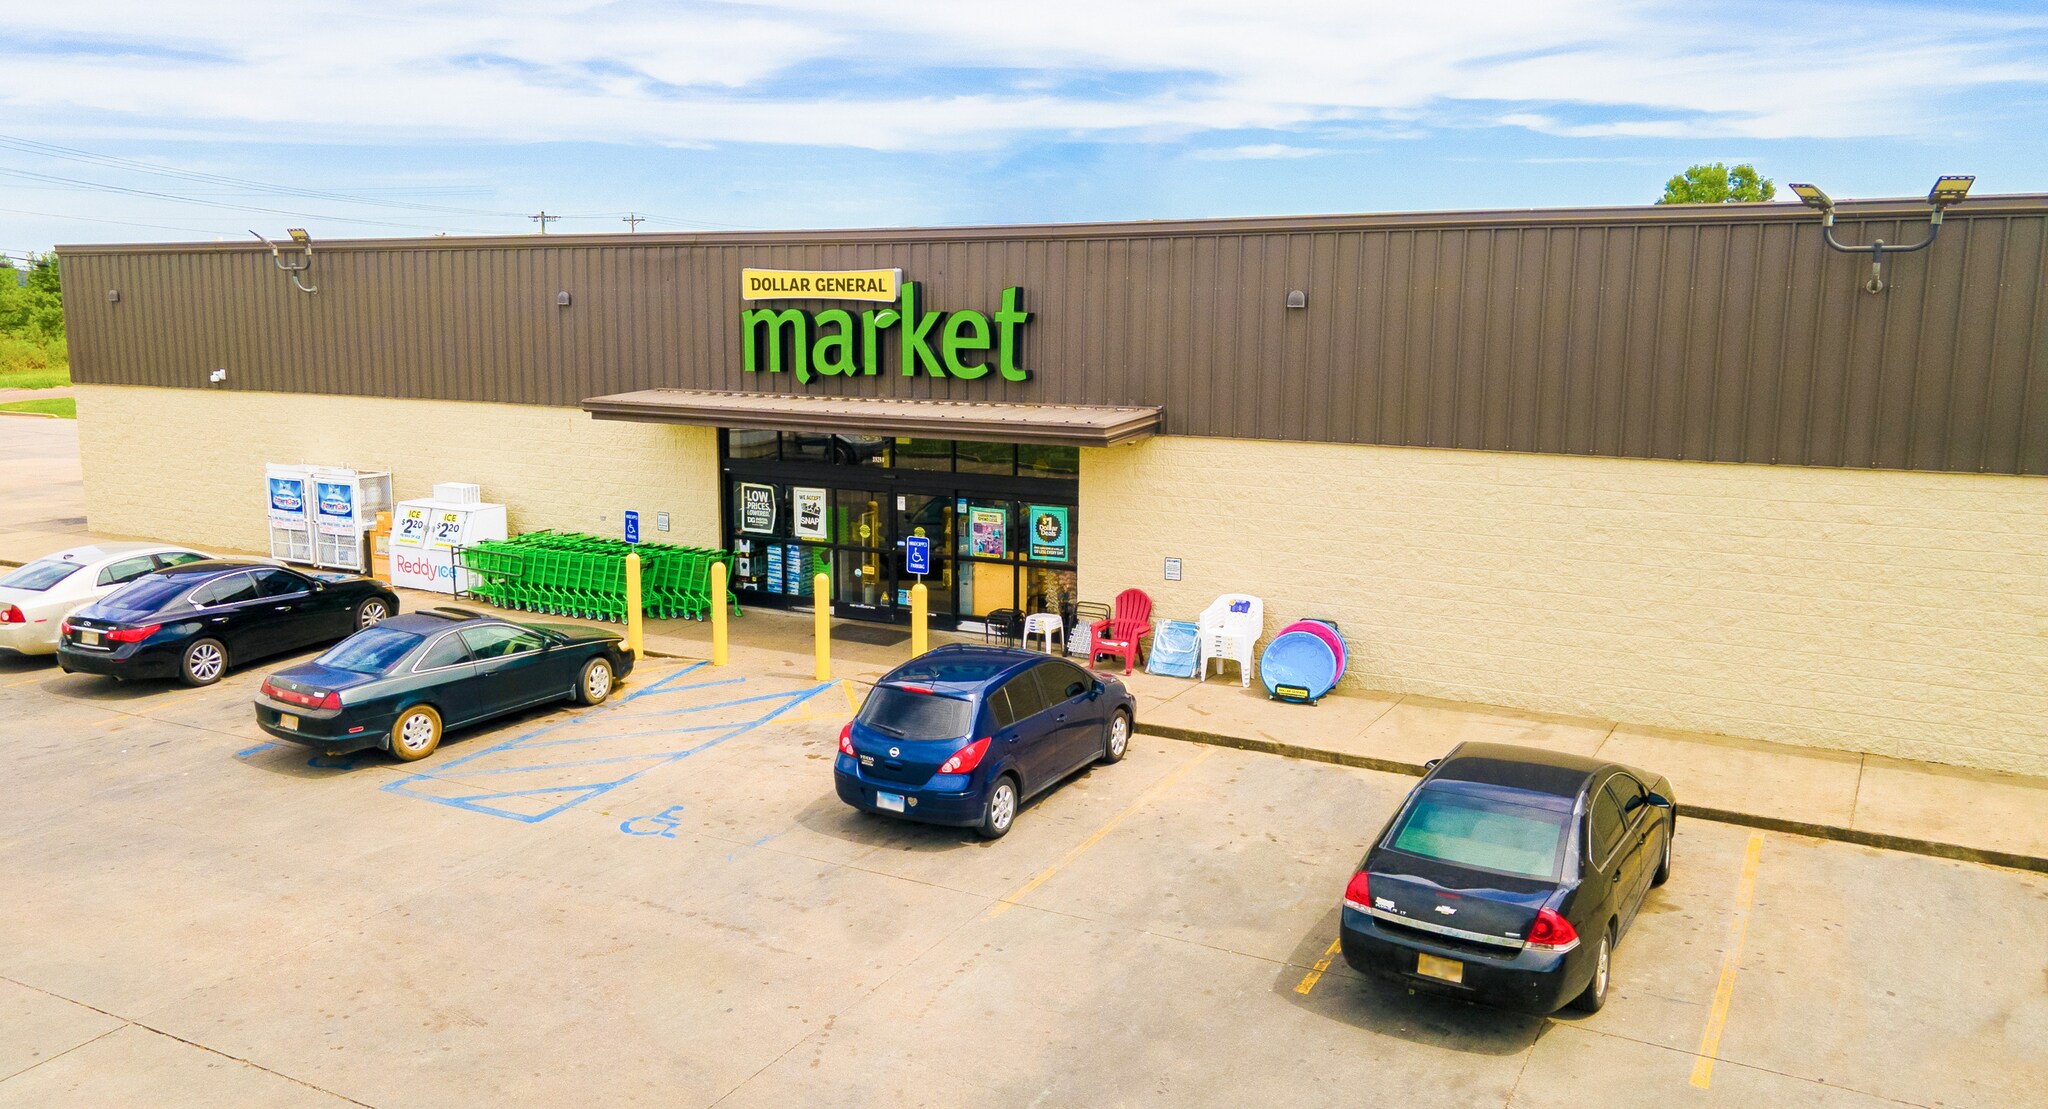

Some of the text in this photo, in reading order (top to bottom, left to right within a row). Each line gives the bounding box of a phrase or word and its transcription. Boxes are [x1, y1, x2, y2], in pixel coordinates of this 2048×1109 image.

[750, 277, 887, 293] DOLLAR GENERAL
[742, 281, 1031, 385] market
[747, 490, 768, 502] LOW
[408, 510, 421, 519] ICE
[444, 513, 457, 522] ICE
[801, 517, 819, 525] SNAP
